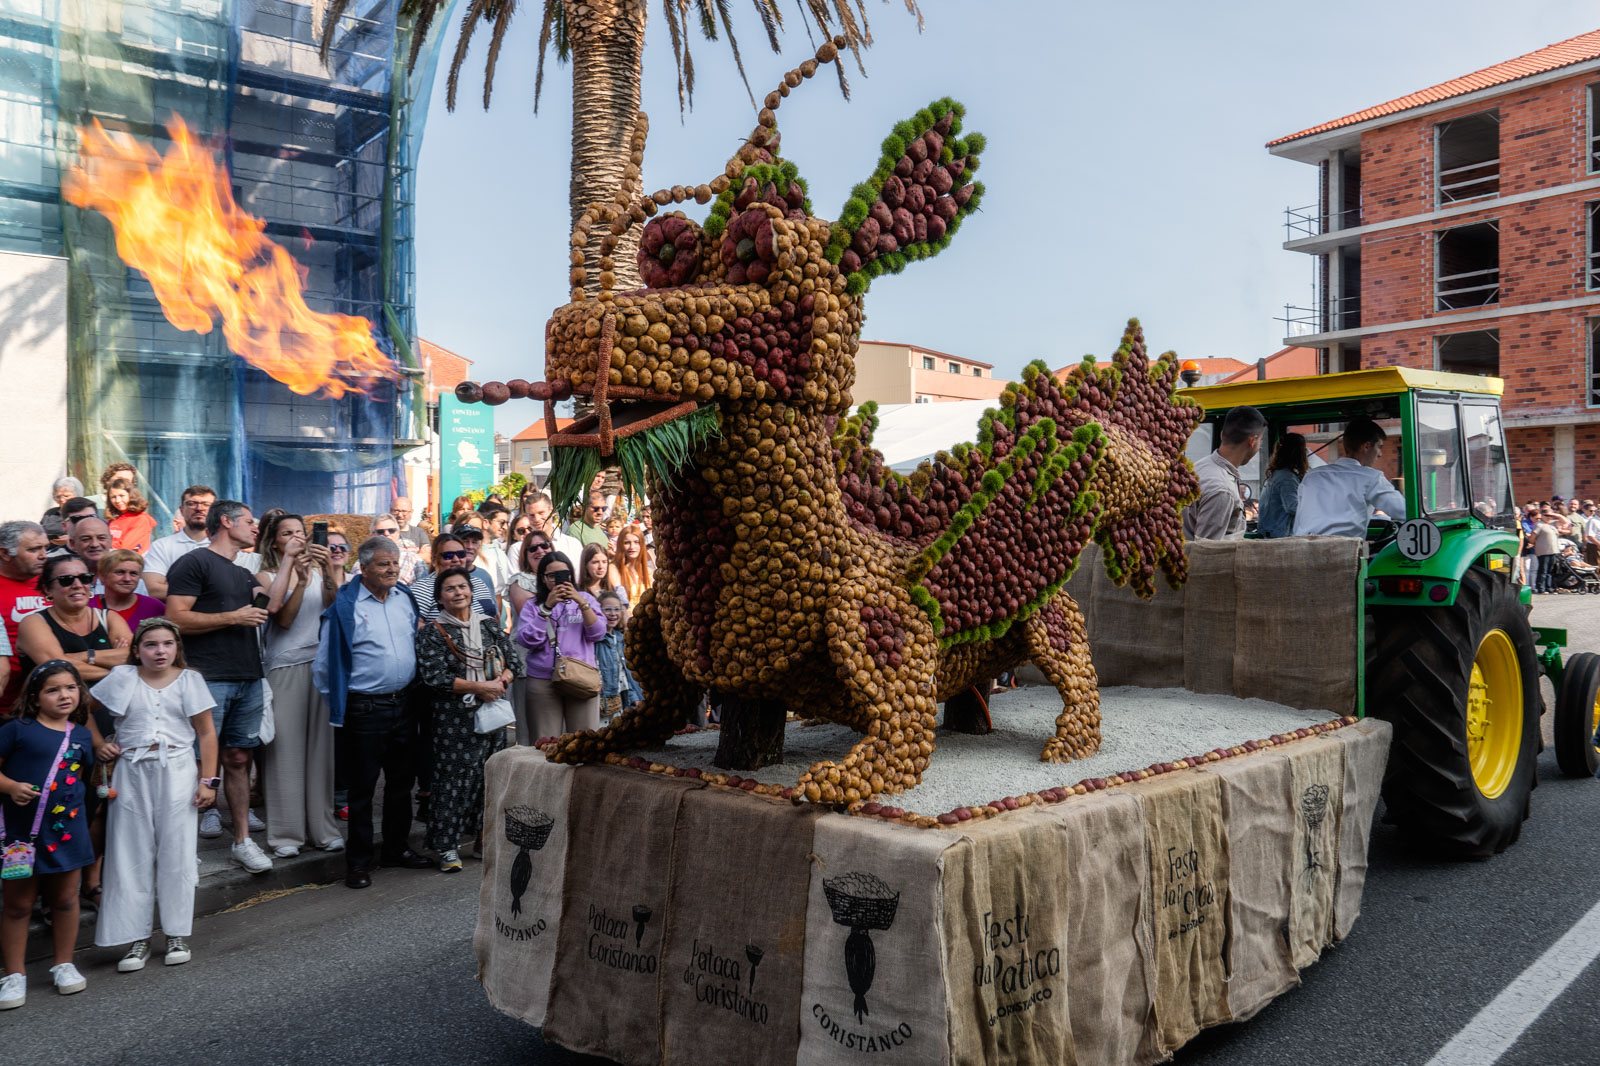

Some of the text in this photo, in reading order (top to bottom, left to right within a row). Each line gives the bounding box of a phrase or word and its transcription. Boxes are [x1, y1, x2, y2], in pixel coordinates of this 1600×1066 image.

[1407, 523, 1430, 555] 30
[16, 596, 46, 610] NIKE
[588, 904, 629, 939] Pataca
[588, 933, 657, 974] Coristanco
[691, 939, 741, 981] Pataca
[684, 966, 695, 986] de
[812, 1003, 913, 1053] CORISTANCO
